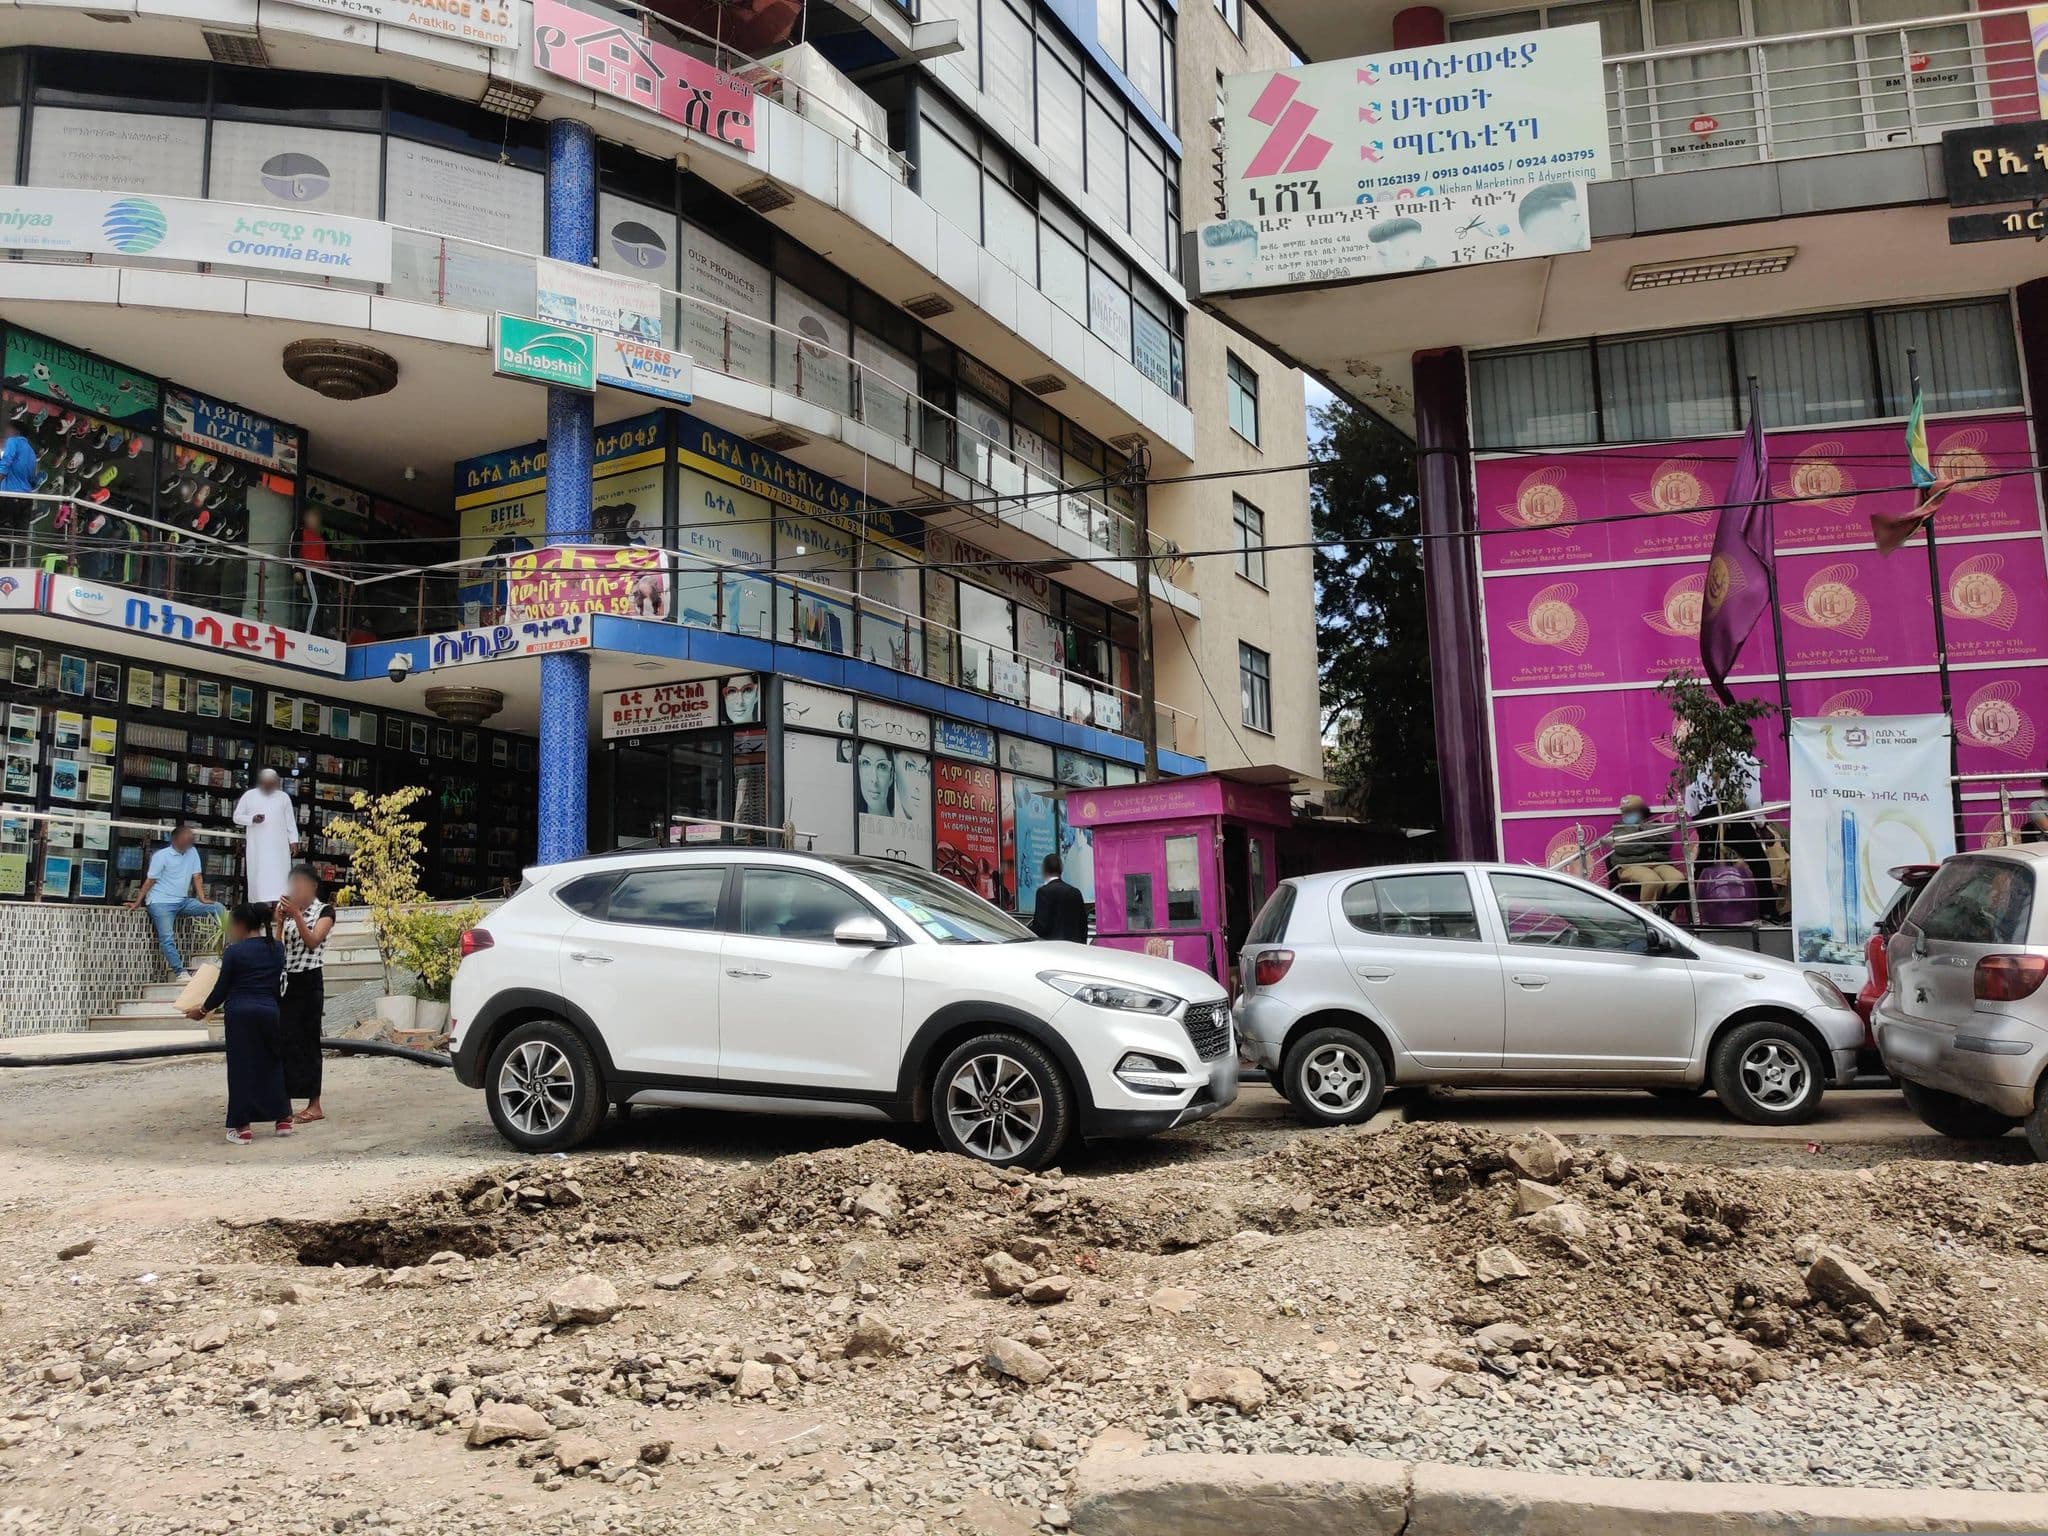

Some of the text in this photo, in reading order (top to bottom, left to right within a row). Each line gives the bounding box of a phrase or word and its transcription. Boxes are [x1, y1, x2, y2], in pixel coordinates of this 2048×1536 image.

[463, 25, 507, 43] Branch
[1389, 42, 1537, 81] ማስታወቂያ
[1393, 117, 1538, 155] ማርኬቲንግ
[1357, 180, 1375, 189] 011
[1377, 173, 1420, 187] 1262139
[1432, 168, 1458, 179] 0913
[1462, 162, 1505, 175] 041405
[1517, 156, 1547, 168] 0924
[1550, 149, 1595, 163] 403795
[1539, 167, 1596, 182] Advertising
[1306, 206, 1379, 227] የወንዶች
[1395, 197, 1456, 216] የውበት
[1472, 190, 1515, 206] ሳሎን
[233, 217, 352, 247] ኦሮሚያ ባንክ
[228, 240, 353, 266] Oromia Bank
[1485, 242, 1514, 259] ፎቅ
[688, 249, 755, 293] OUR PRODUCTS
[503, 347, 582, 376] Dahabshiil
[615, 341, 671, 365] XPRESS
[632, 358, 682, 379] MONEY
[739, 474, 765, 494] 0911
[491, 503, 525, 524] BETEL
[561, 600, 579, 614] 26
[611, 597, 630, 613] 59
[522, 616, 583, 638] ማተሚያ
[613, 707, 653, 722] BETY
[658, 700, 709, 718] Optics
